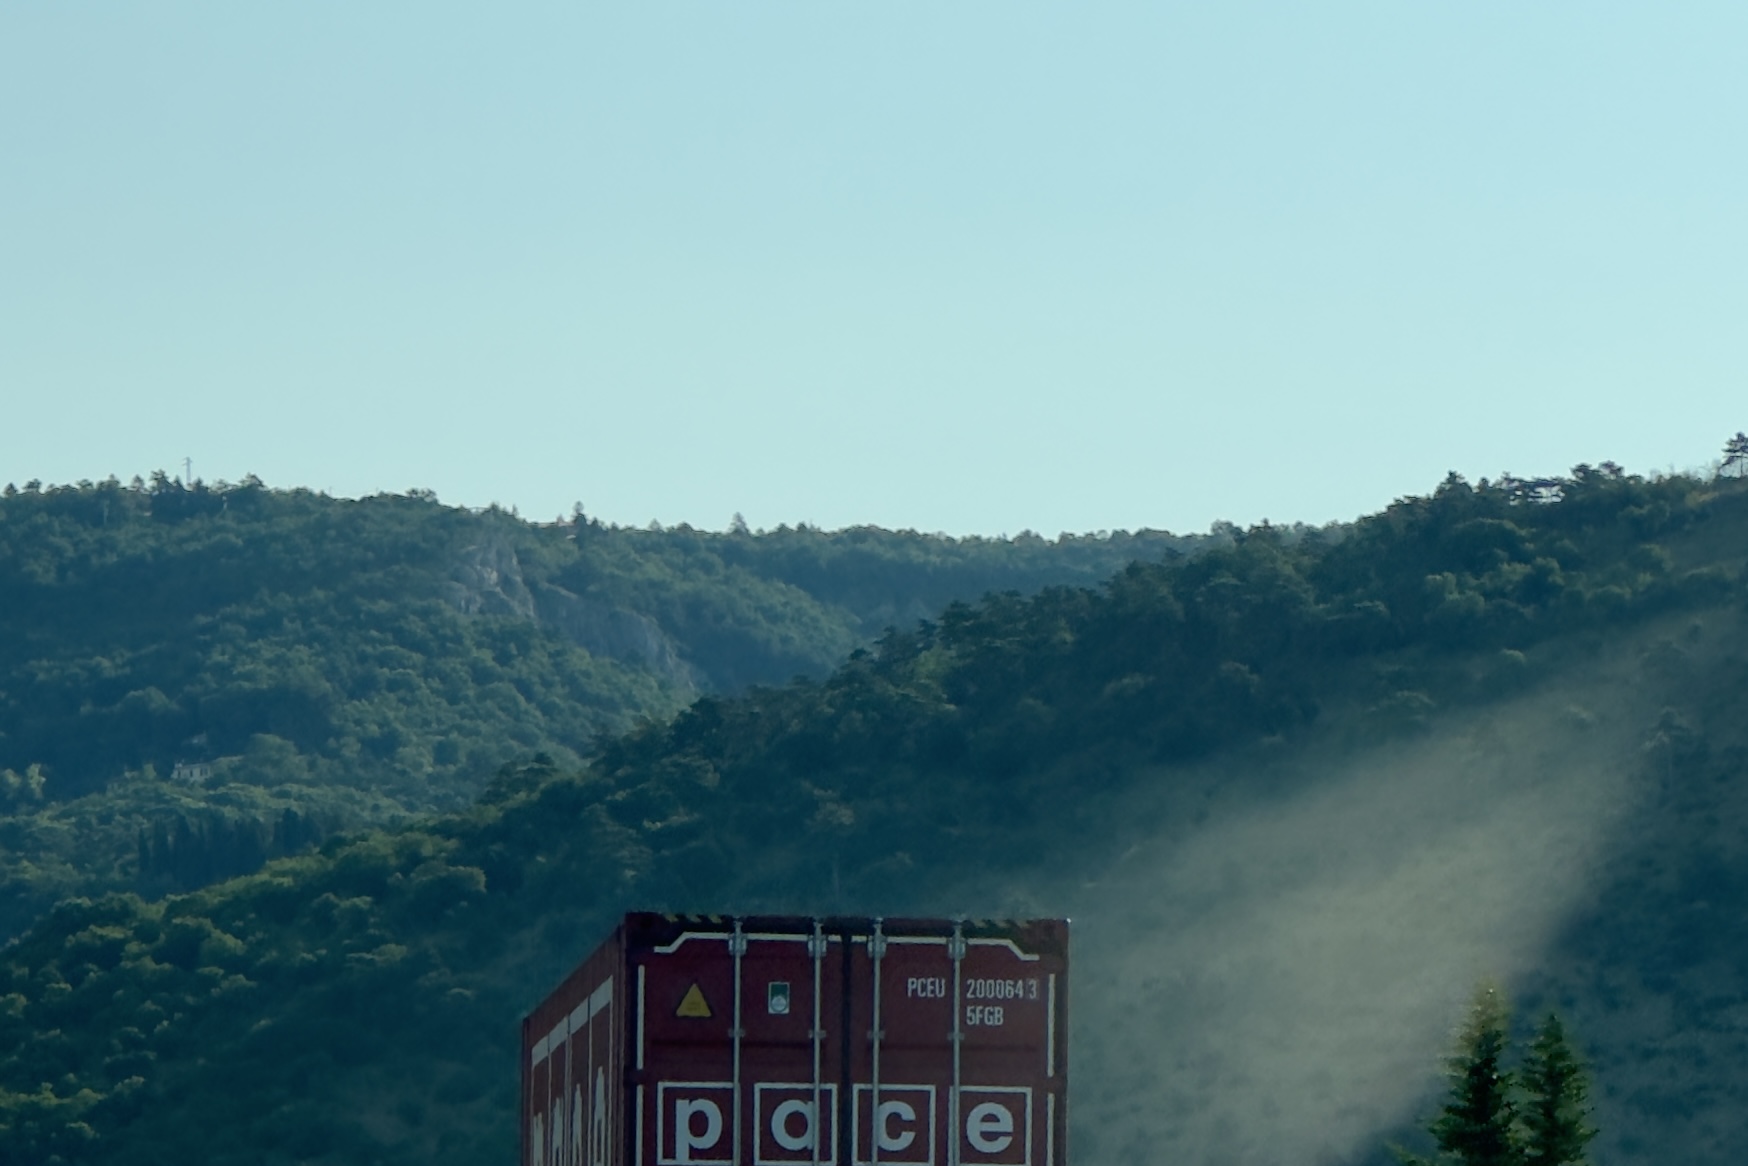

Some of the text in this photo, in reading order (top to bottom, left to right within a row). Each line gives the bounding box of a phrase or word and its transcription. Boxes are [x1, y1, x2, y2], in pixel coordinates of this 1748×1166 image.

[907, 976, 946, 998] PCEU
[966, 1005, 1004, 1026] 5FGB
[675, 1098, 1014, 1161] pace
